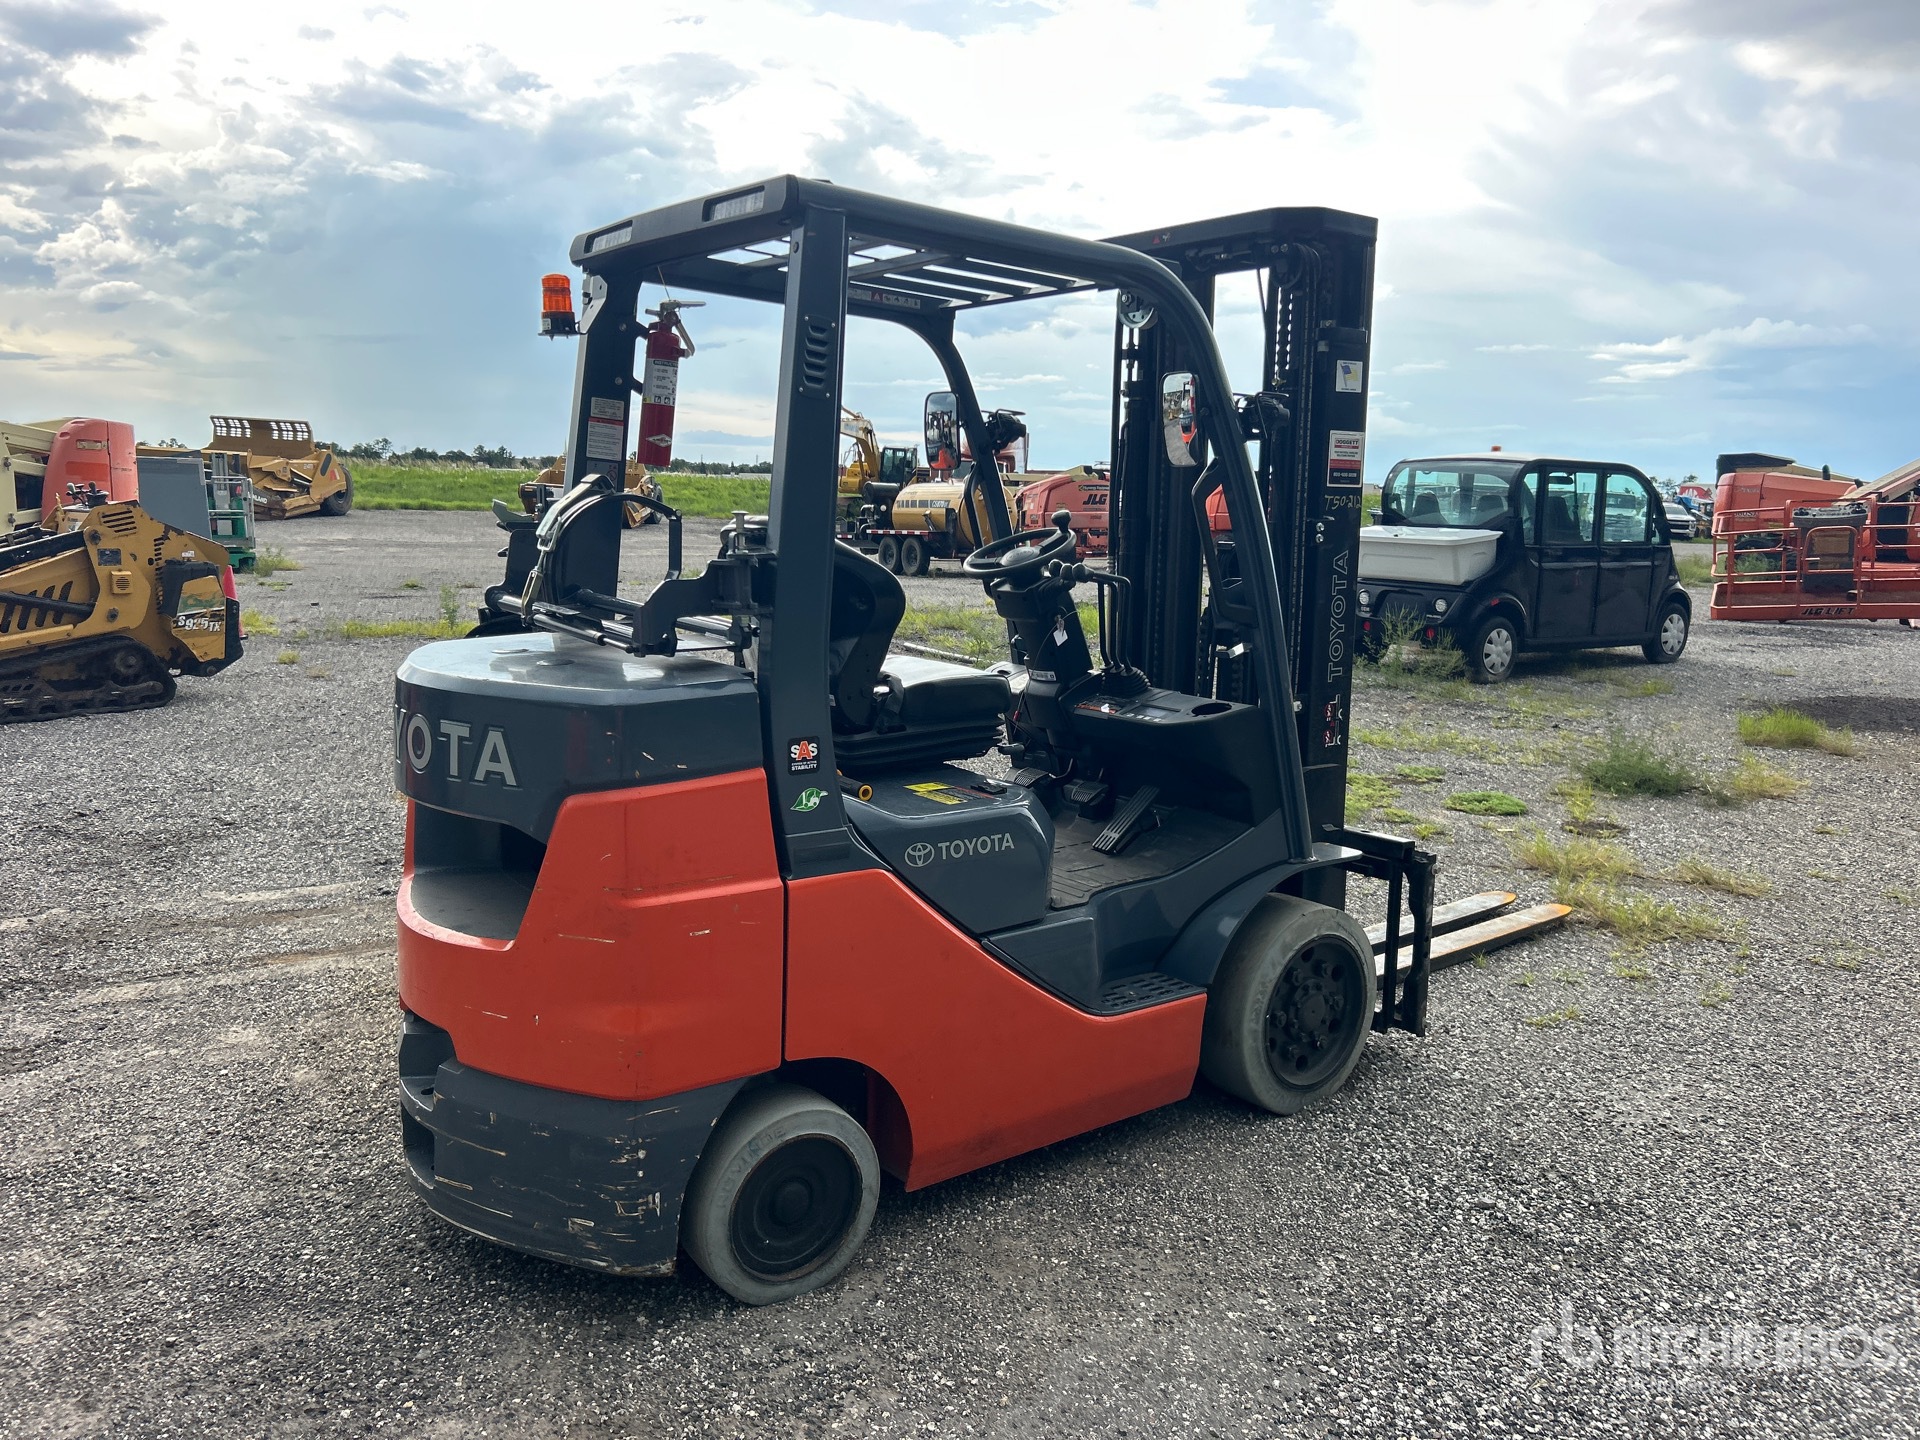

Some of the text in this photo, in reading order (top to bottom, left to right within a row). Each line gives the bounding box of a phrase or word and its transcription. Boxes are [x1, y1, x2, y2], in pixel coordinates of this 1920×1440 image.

[1083, 494, 1108, 505] JLG
[1328, 550, 1349, 682] TOYOTA
[1802, 607, 1855, 615] JLG LIFT
[790, 741, 818, 760] SAS
[791, 763, 818, 771] STABILITY
[938, 833, 1015, 859] TOYOTA
